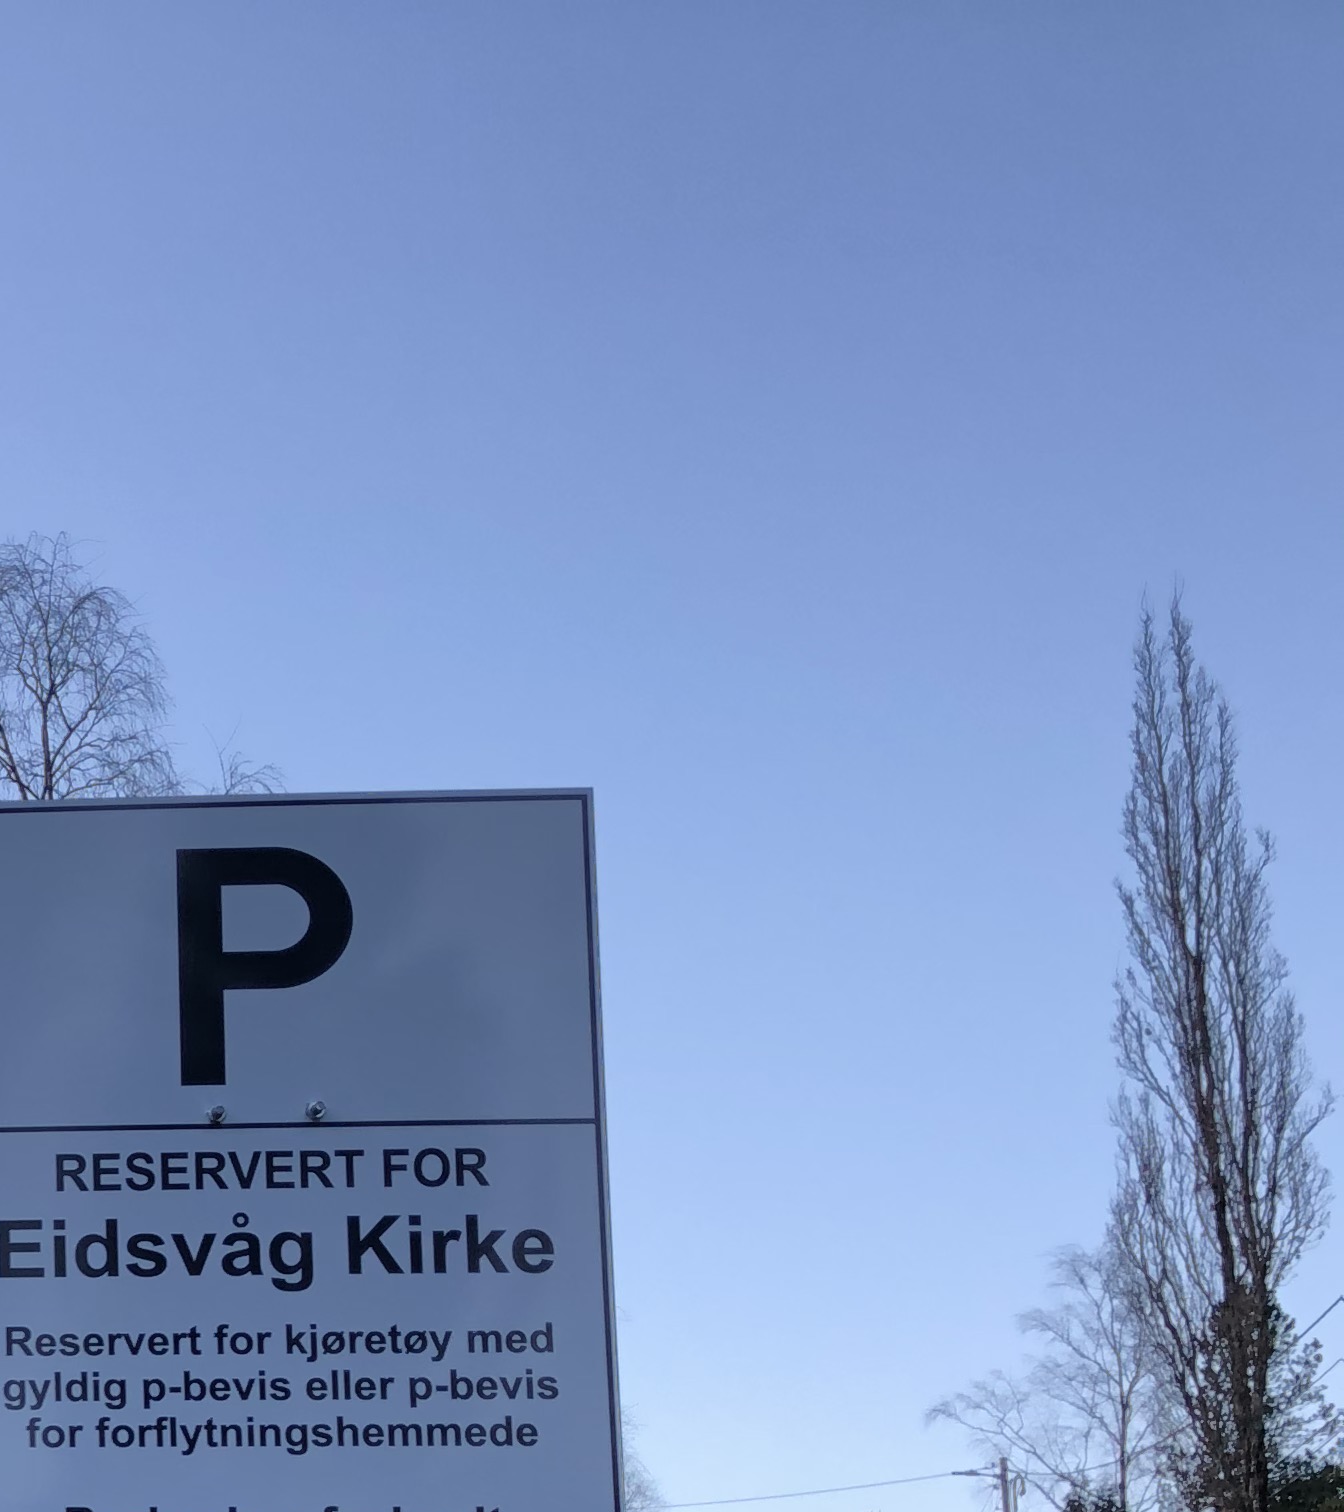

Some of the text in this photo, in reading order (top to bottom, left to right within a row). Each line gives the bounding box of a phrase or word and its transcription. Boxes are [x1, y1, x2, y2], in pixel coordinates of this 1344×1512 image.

[174, 845, 355, 1088] P
[54, 1146, 491, 1193] RESERVERT FOR
[345, 1213, 555, 1276] Kirke
[5, 1321, 555, 1364] Reservert for kjøretøy med
[2, 1367, 560, 1412] gyldig p-bevis eller p-bevis
[25, 1414, 539, 1457] for forflytningshemmede
